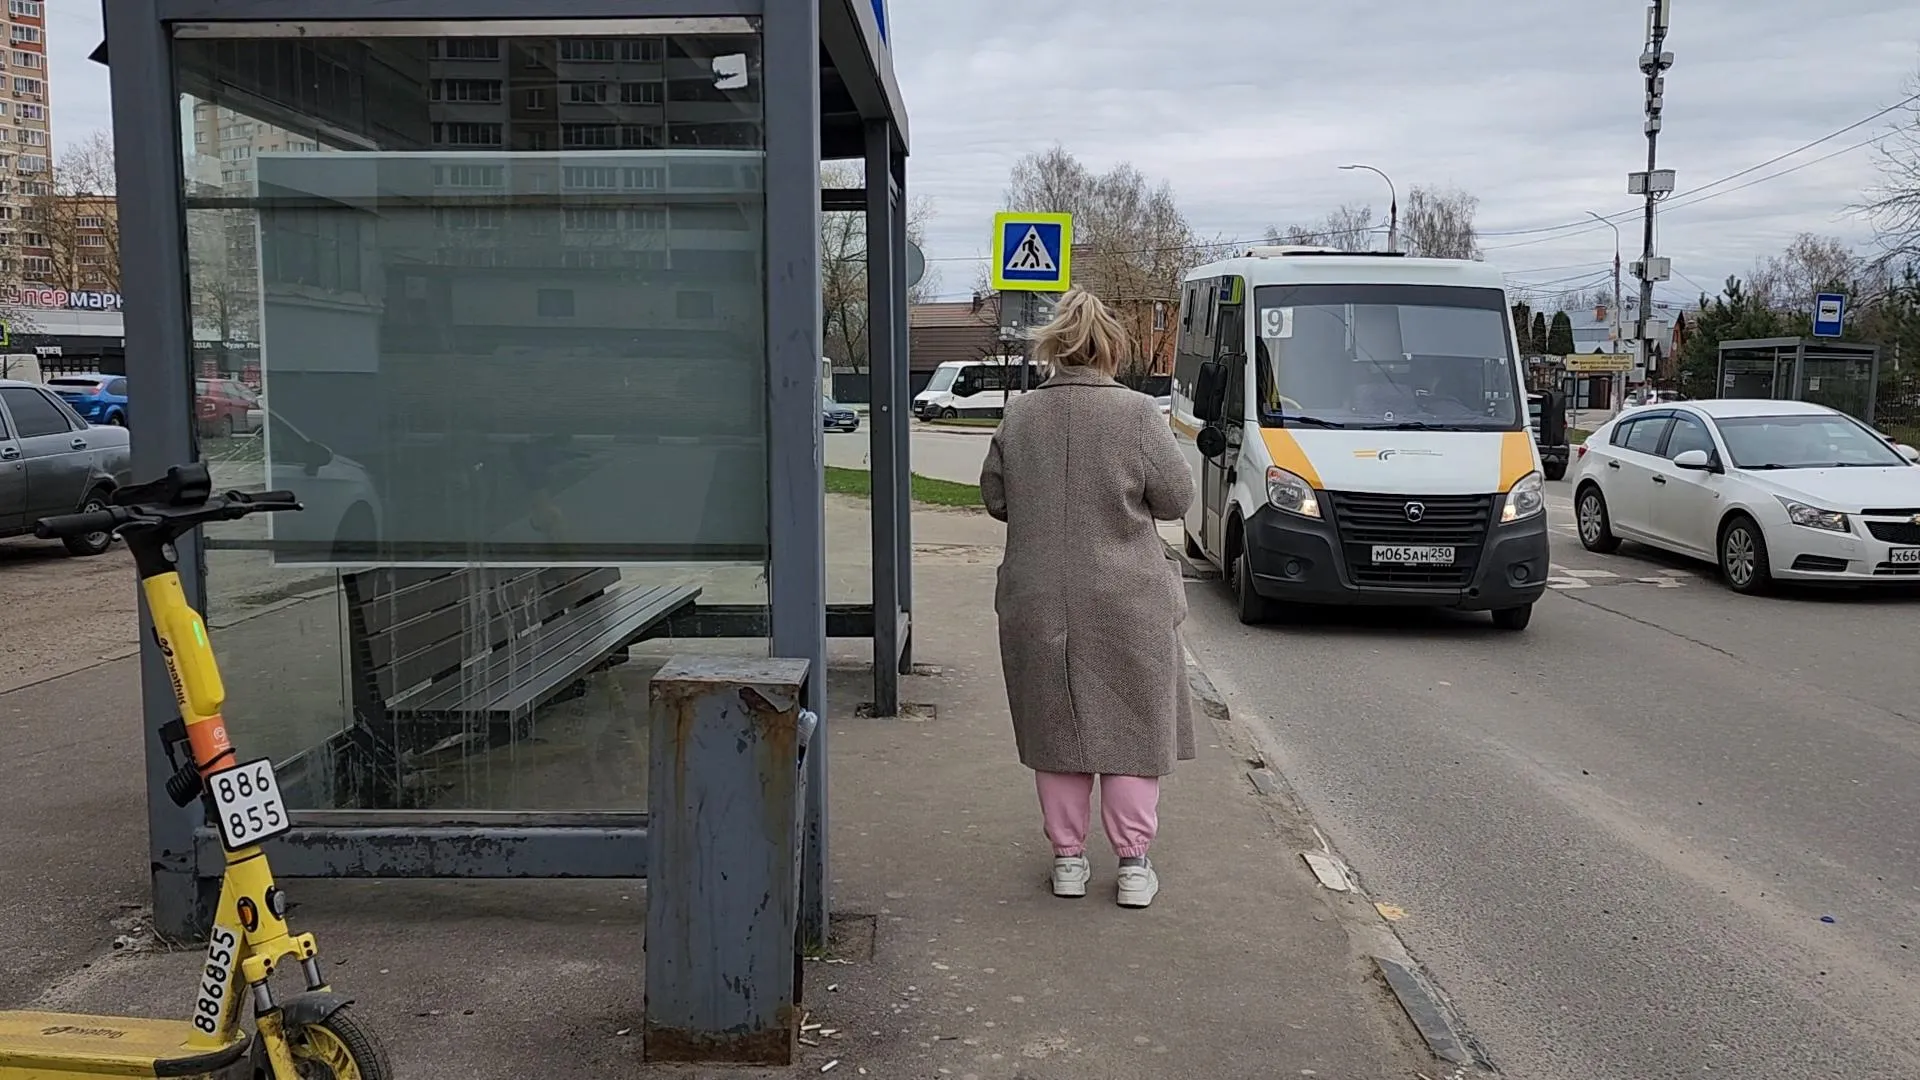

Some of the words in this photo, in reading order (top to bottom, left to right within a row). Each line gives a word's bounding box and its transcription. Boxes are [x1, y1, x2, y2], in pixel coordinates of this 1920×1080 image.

[1267, 309, 1284, 337] 9
[1430, 548, 1452, 558] 250
[218, 766, 270, 804] 886
[229, 800, 280, 839] 855
[194, 927, 235, 1034] 886855
